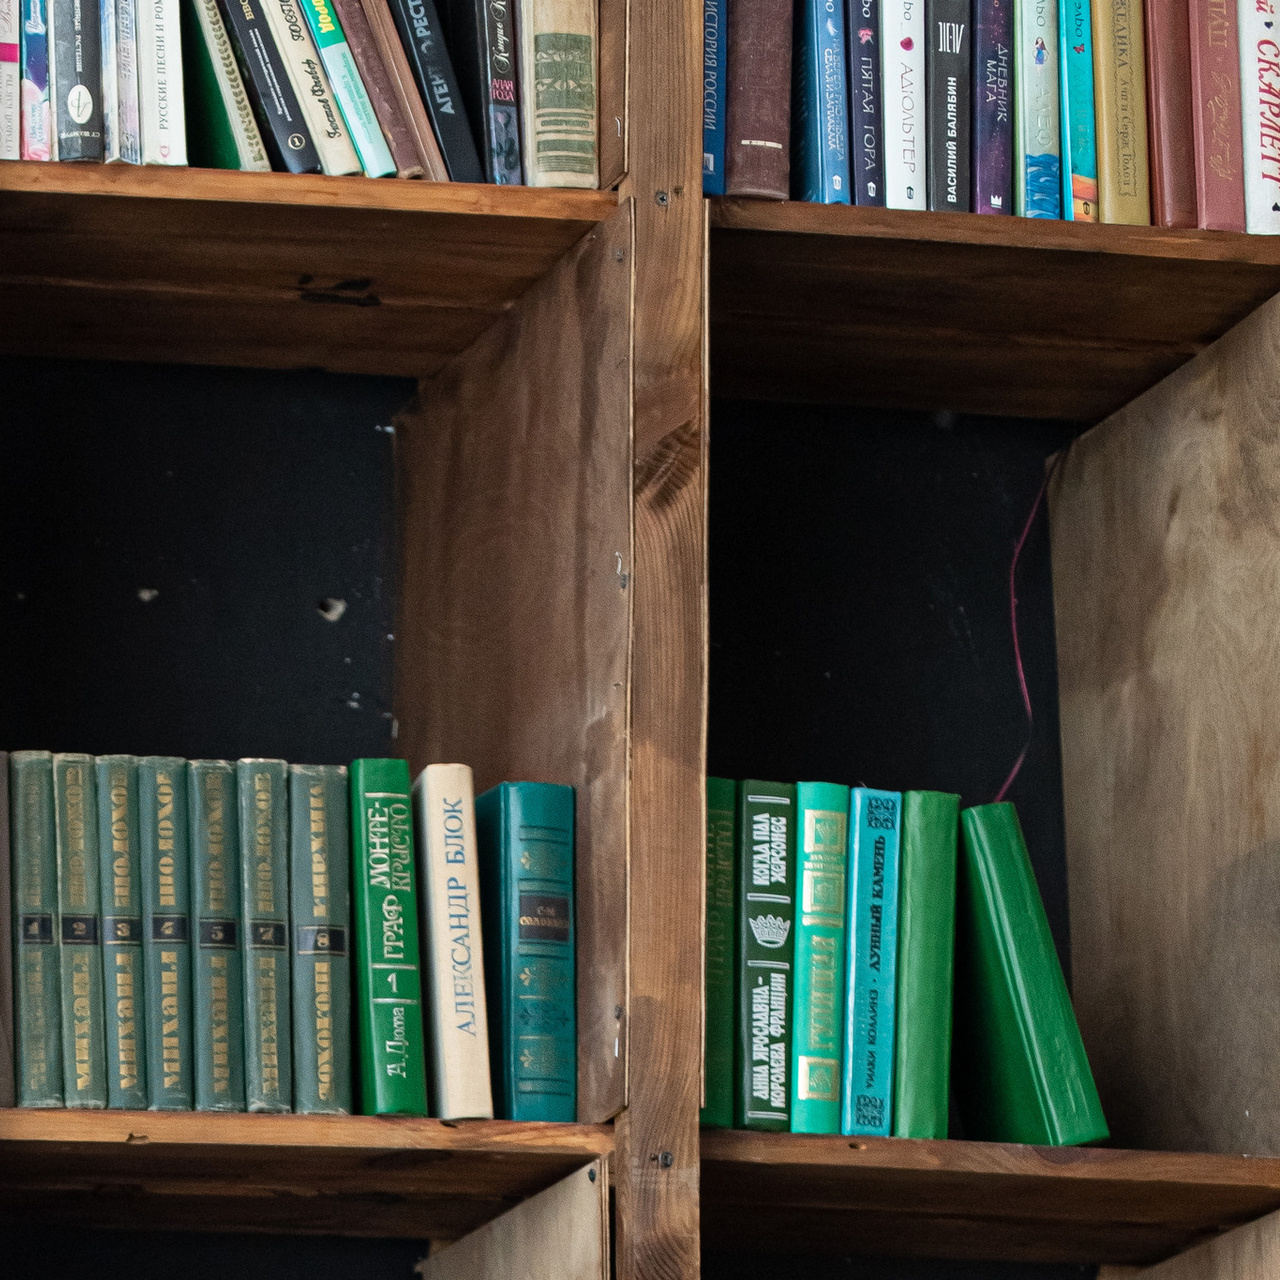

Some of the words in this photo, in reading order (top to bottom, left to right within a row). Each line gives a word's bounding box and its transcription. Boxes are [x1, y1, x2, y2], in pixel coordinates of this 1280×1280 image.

[155, 35, 167, 75] ПЕСНИ
[703, 0, 719, 64] ИСТОРИЯ
[157, 79, 170, 131] РУССКИЕ
[301, 58, 325, 98] Флобер
[490, 88, 516, 103] РОЗА
[703, 65, 718, 132] РОССИИ
[860, 56, 876, 114] ПЯТАЯ
[946, 76, 959, 138] БАЛЯБИН
[985, 59, 997, 103] МАГА
[997, 43, 1009, 122] ДНЕВНИК
[863, 124, 877, 172] ГОРА
[946, 138, 959, 203] ВАСИЛИЙ
[111, 772, 131, 908] ШОЛОХОВ
[156, 772, 176, 907] ШОЛОХОВ
[367, 800, 392, 891] МОНТЕ-
[387, 802, 412, 893] КРИСТО
[442, 797, 467, 866] БЛОК
[752, 812, 771, 842] ПАЛ
[769, 815, 788, 885] ХЕРСОНЕС
[752, 842, 771, 887] КОГДА
[871, 835, 888, 899] КАМЕНЬ
[381, 893, 406, 961] ГРАФ
[446, 876, 478, 1038] АЛЕКСАНДР
[868, 904, 883, 972] ЛУННЫЙ
[116, 952, 138, 1090] МИХАИЛ
[160, 950, 180, 1089] МИХАИЛ
[381, 1006, 409, 1057] Дюма
[752, 975, 771, 1062] ЯРОСЛАВНА-
[769, 972, 788, 1039] ФРАНЦИИ
[867, 988, 879, 1046] КОЛЛИНЗ
[752, 1063, 771, 1101] АННА
[769, 1042, 787, 1109] КОРОЛЕВА
[865, 1050, 876, 1089] УИЛКИ
